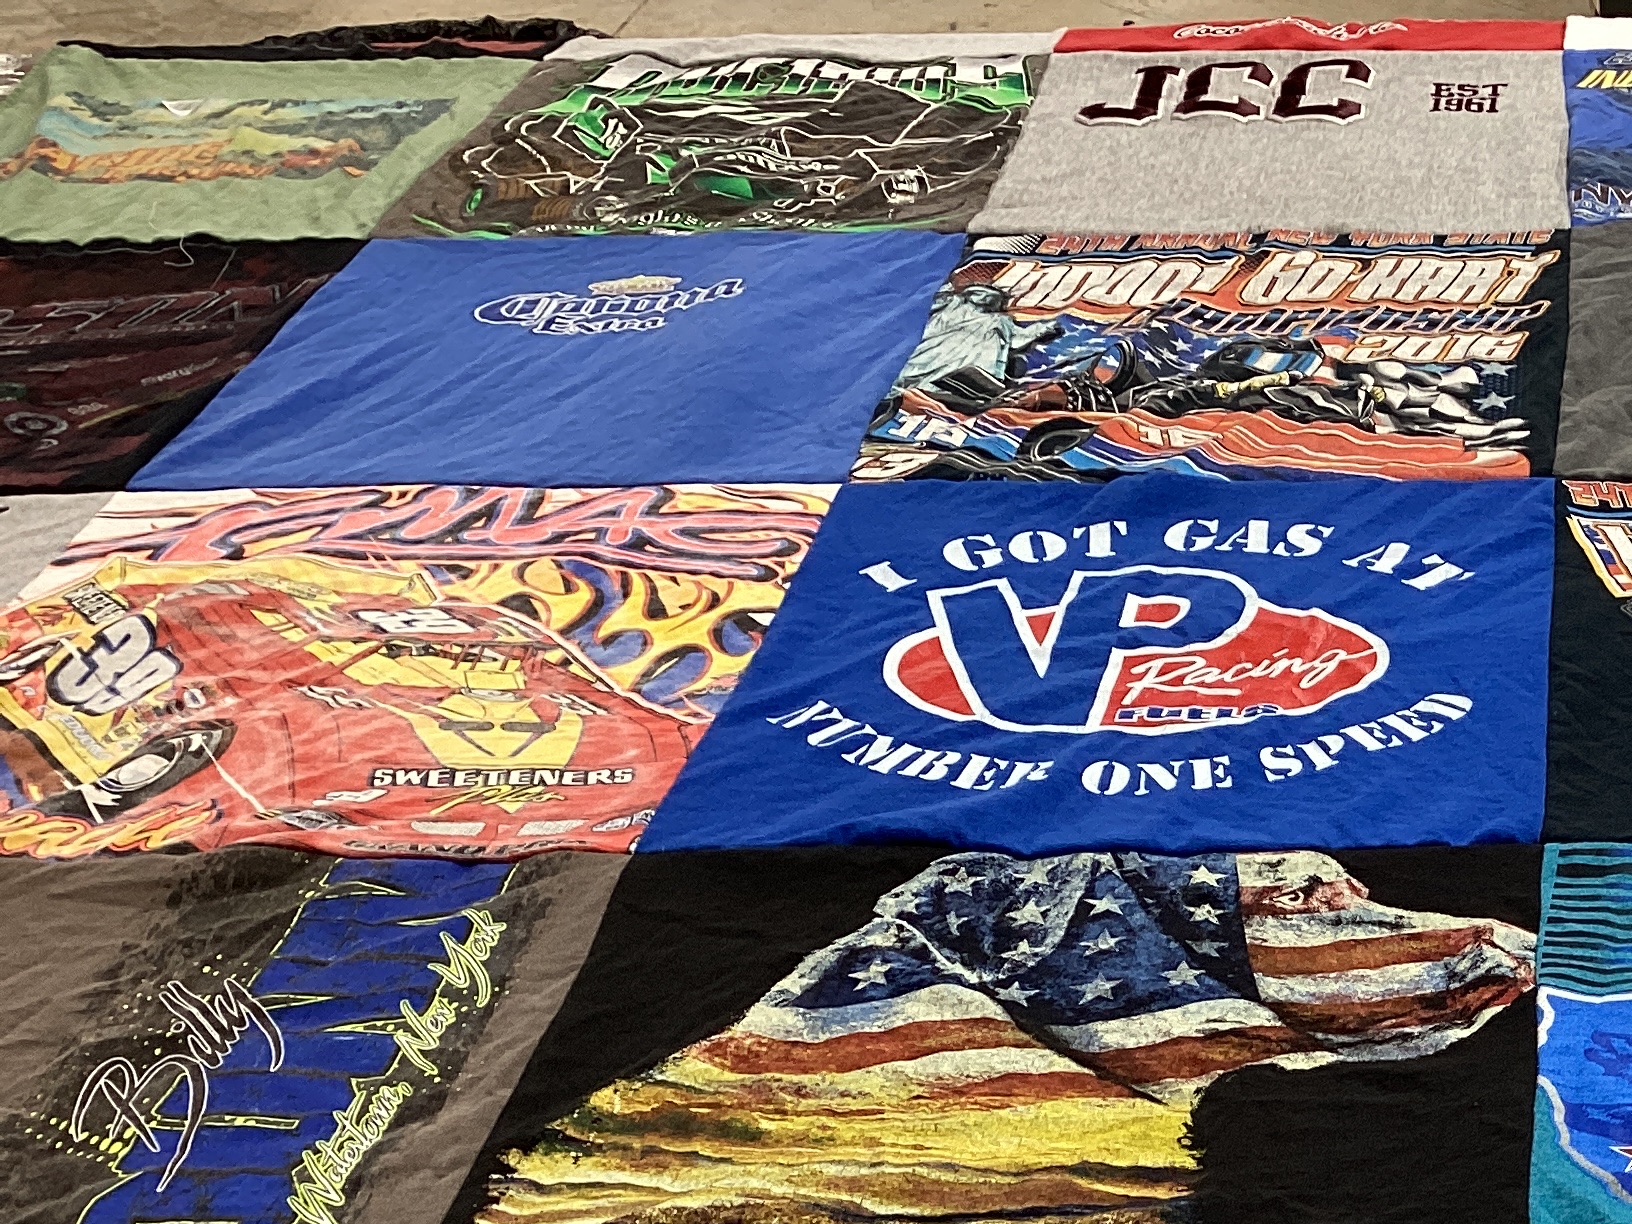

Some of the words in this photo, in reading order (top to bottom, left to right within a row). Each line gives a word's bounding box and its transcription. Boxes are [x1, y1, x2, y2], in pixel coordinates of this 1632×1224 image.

[1074, 58, 1375, 126] JCC
[1429, 97, 1500, 113] 1961
[1430, 82, 1508, 98] EST
[1266, 228, 1338, 247] NEW
[1444, 227, 1551, 246] STATE
[473, 277, 744, 325] Corona
[1344, 332, 1531, 363] 2016
[860, 558, 917, 594] I
[941, 518, 1129, 572] GOT
[1163, 517, 1336, 558] GAS
[1342, 541, 1476, 592] AT
[926, 564, 1260, 735] VP
[1121, 646, 1374, 706] Racing
[1113, 702, 1285, 724] FUELS
[766, 699, 1052, 792] NUMBER
[1081, 756, 1233, 797] ONE
[1259, 691, 1475, 784] SPEED
[372, 767, 635, 788] SWEETENERS
[395, 995, 452, 1076] New
[428, 905, 507, 1008] York
[71, 978, 286, 1193] Billy
